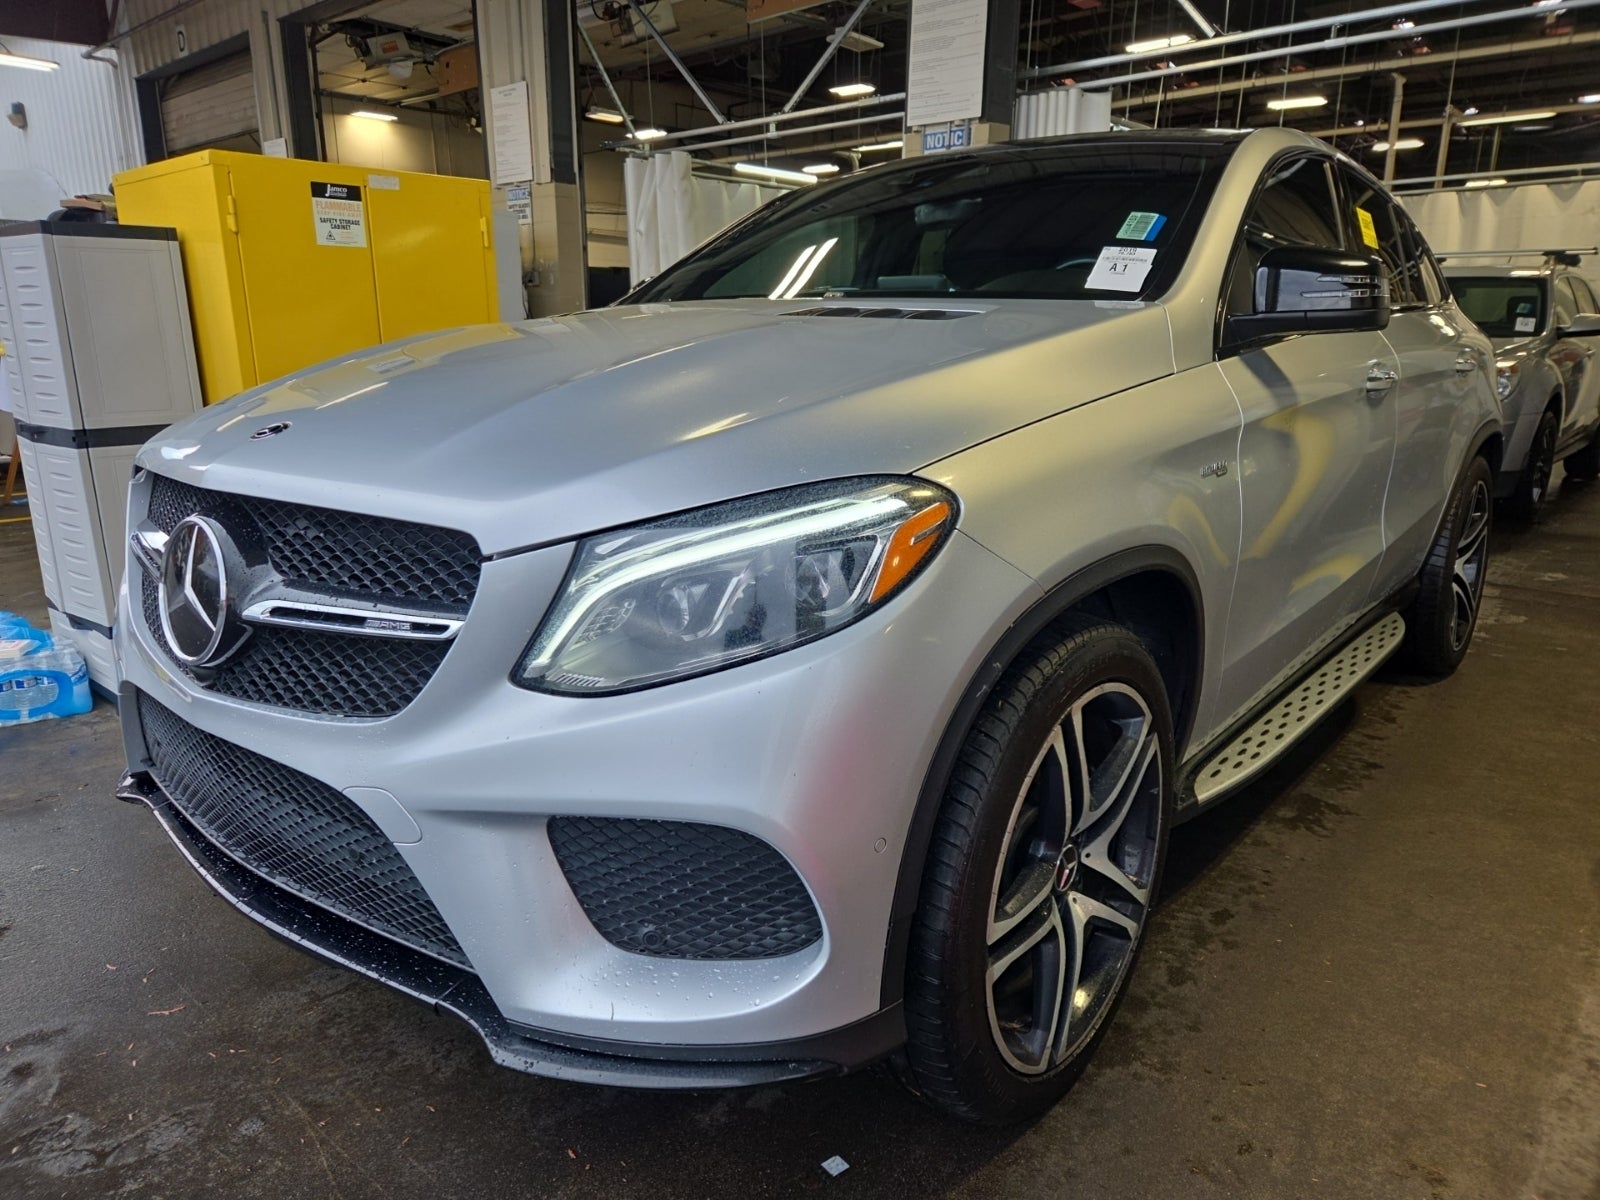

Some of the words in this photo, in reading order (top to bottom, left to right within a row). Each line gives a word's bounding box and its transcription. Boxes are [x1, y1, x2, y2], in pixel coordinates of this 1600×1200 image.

[926, 130, 969, 149] NOTIC
[325, 184, 348, 197] Jamco
[315, 200, 361, 211] FLAMMABLE
[339, 218, 360, 226] STORAGE
[1109, 263, 1117, 272] A
[379, 620, 411, 630] AMG
